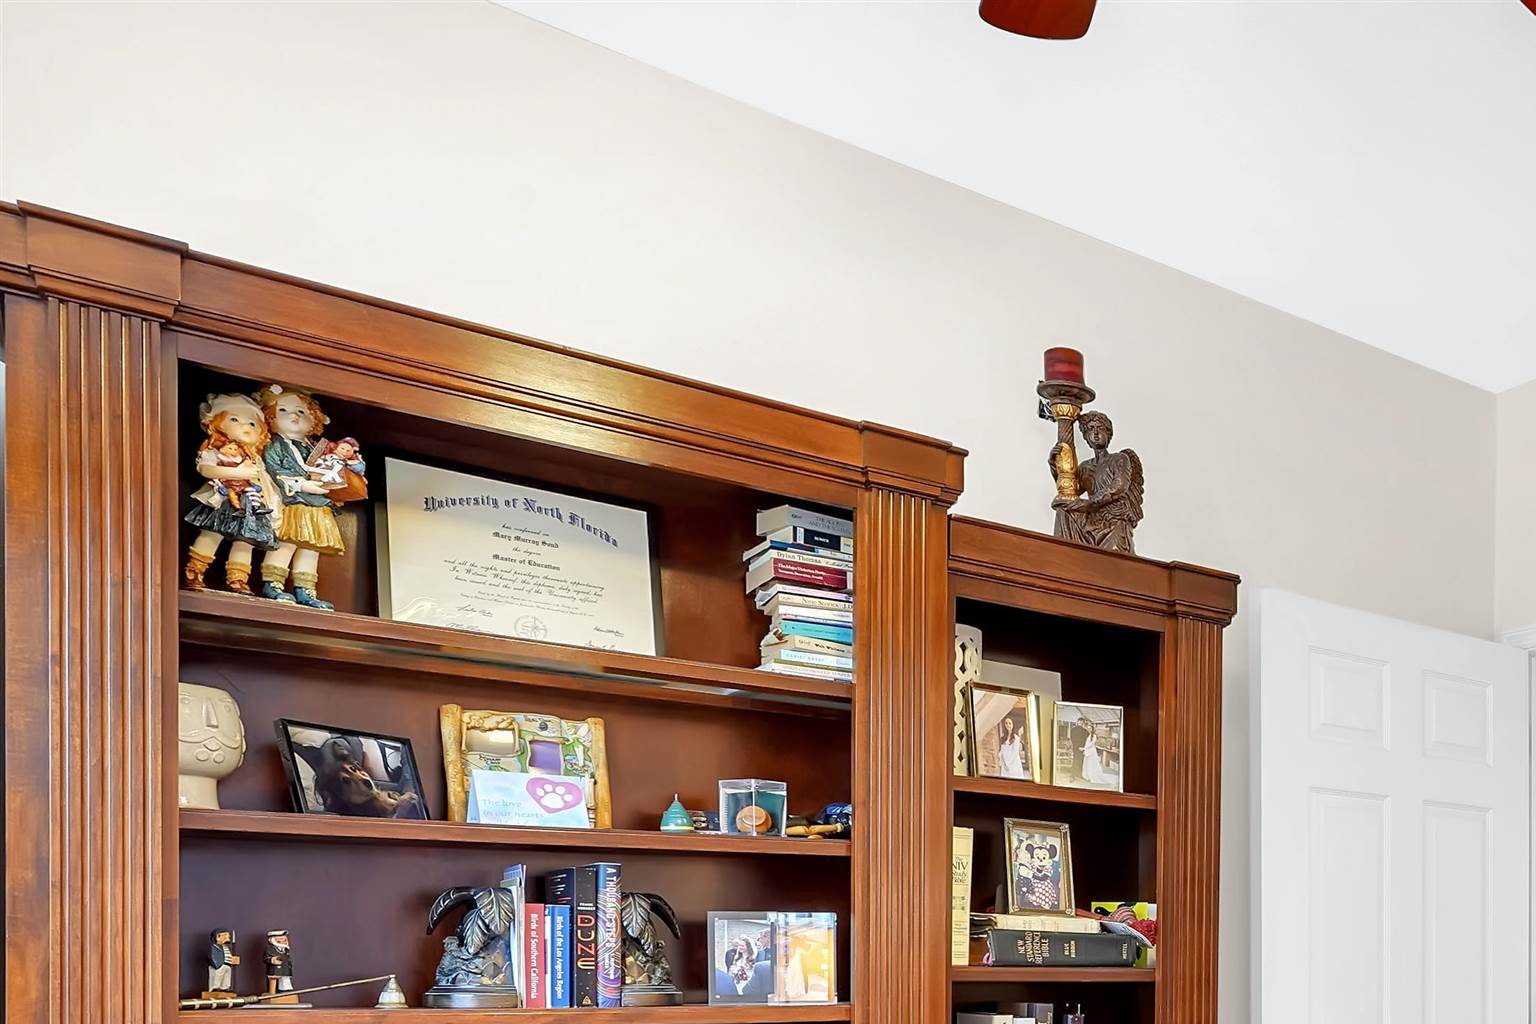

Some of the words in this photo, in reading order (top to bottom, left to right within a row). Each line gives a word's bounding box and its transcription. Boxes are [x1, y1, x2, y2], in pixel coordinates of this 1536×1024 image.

[424, 494, 499, 512] University
[504, 497, 519, 508] of
[523, 497, 564, 523] North
[568, 511, 619, 548] Florida
[492, 553, 517, 564] Master
[527, 558, 560, 571] Education
[777, 551, 796, 560] Dylan
[952, 861, 969, 871] NIV
[605, 876, 617, 920] THOUSAND
[530, 913, 538, 930] Birds
[555, 915, 563, 930] Birds
[605, 921, 617, 947] STEPS
[530, 938, 538, 967] Southern
[576, 914, 596, 970] DUNE
[1017, 939, 1025, 955] NEW
[1026, 931, 1035, 963] STANDARD
[1035, 931, 1043, 965] REFERENCE
[1042, 938, 1050, 959] BIBLE
[530, 967, 538, 999] California
